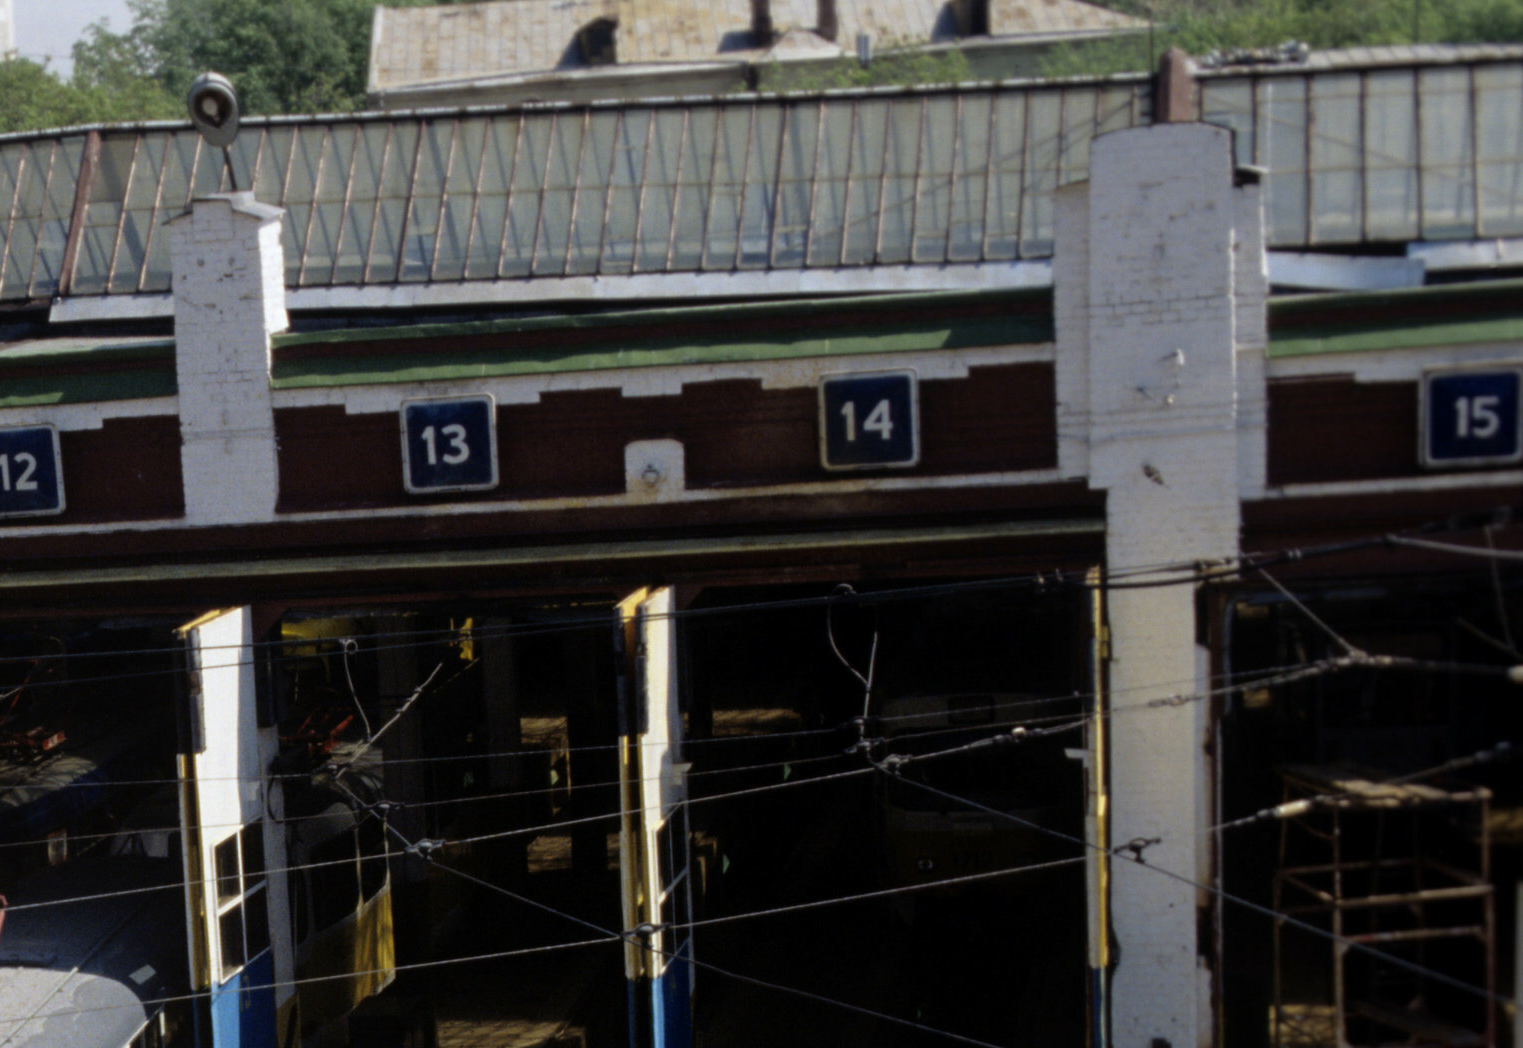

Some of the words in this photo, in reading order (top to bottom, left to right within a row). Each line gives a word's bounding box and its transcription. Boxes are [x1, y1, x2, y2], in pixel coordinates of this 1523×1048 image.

[840, 399, 893, 441] 14
[1455, 396, 1500, 438] 15
[420, 423, 471, 465] 13
